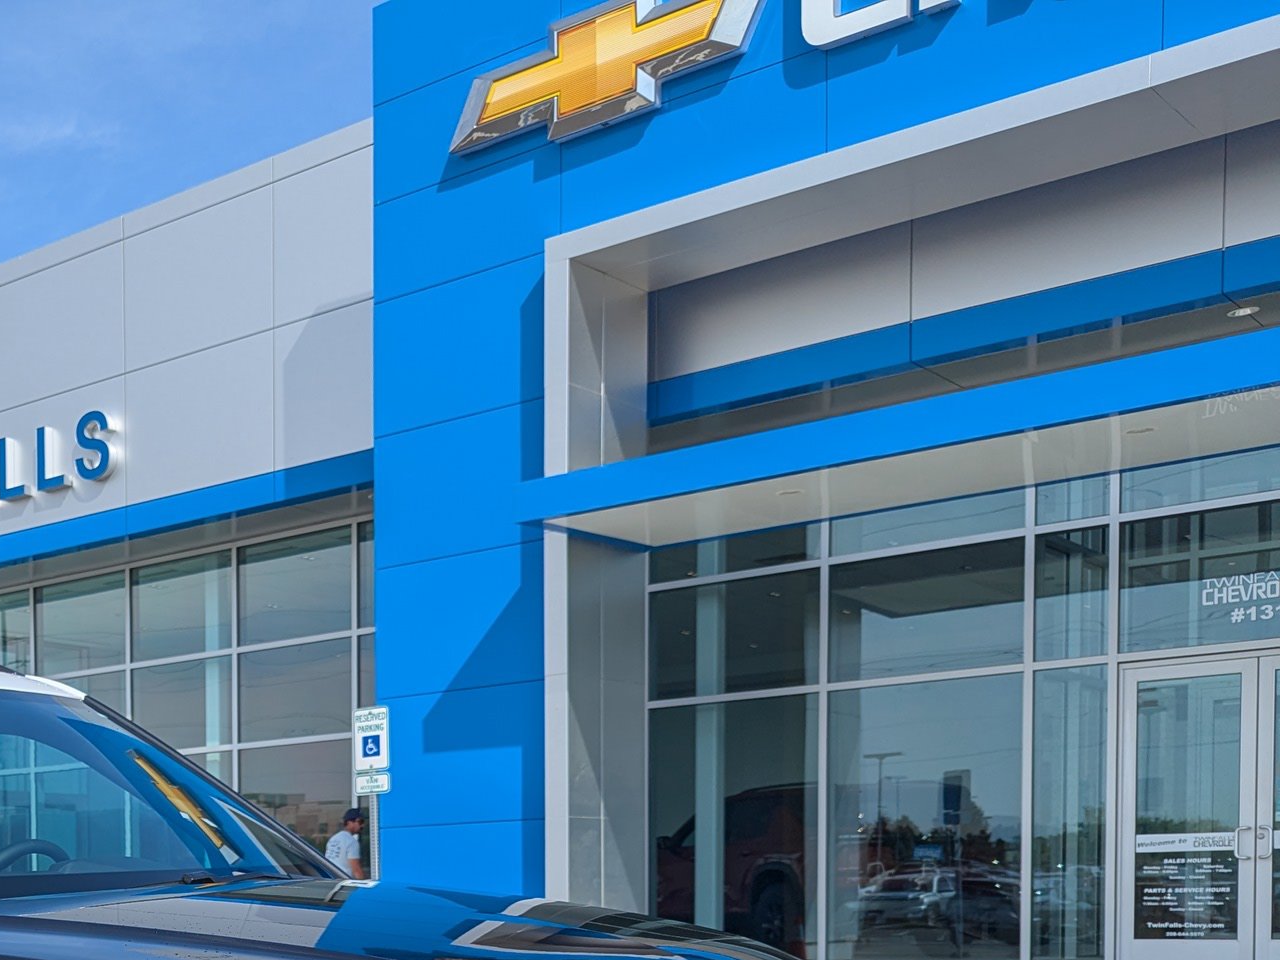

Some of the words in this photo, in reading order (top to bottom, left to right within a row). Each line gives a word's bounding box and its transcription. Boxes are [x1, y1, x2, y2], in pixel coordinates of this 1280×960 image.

[1230, 604, 1280, 623] #13
[355, 712, 386, 723] RESERVED
[357, 723, 385, 734] PARKING
[1137, 839, 1177, 848] Welcome
